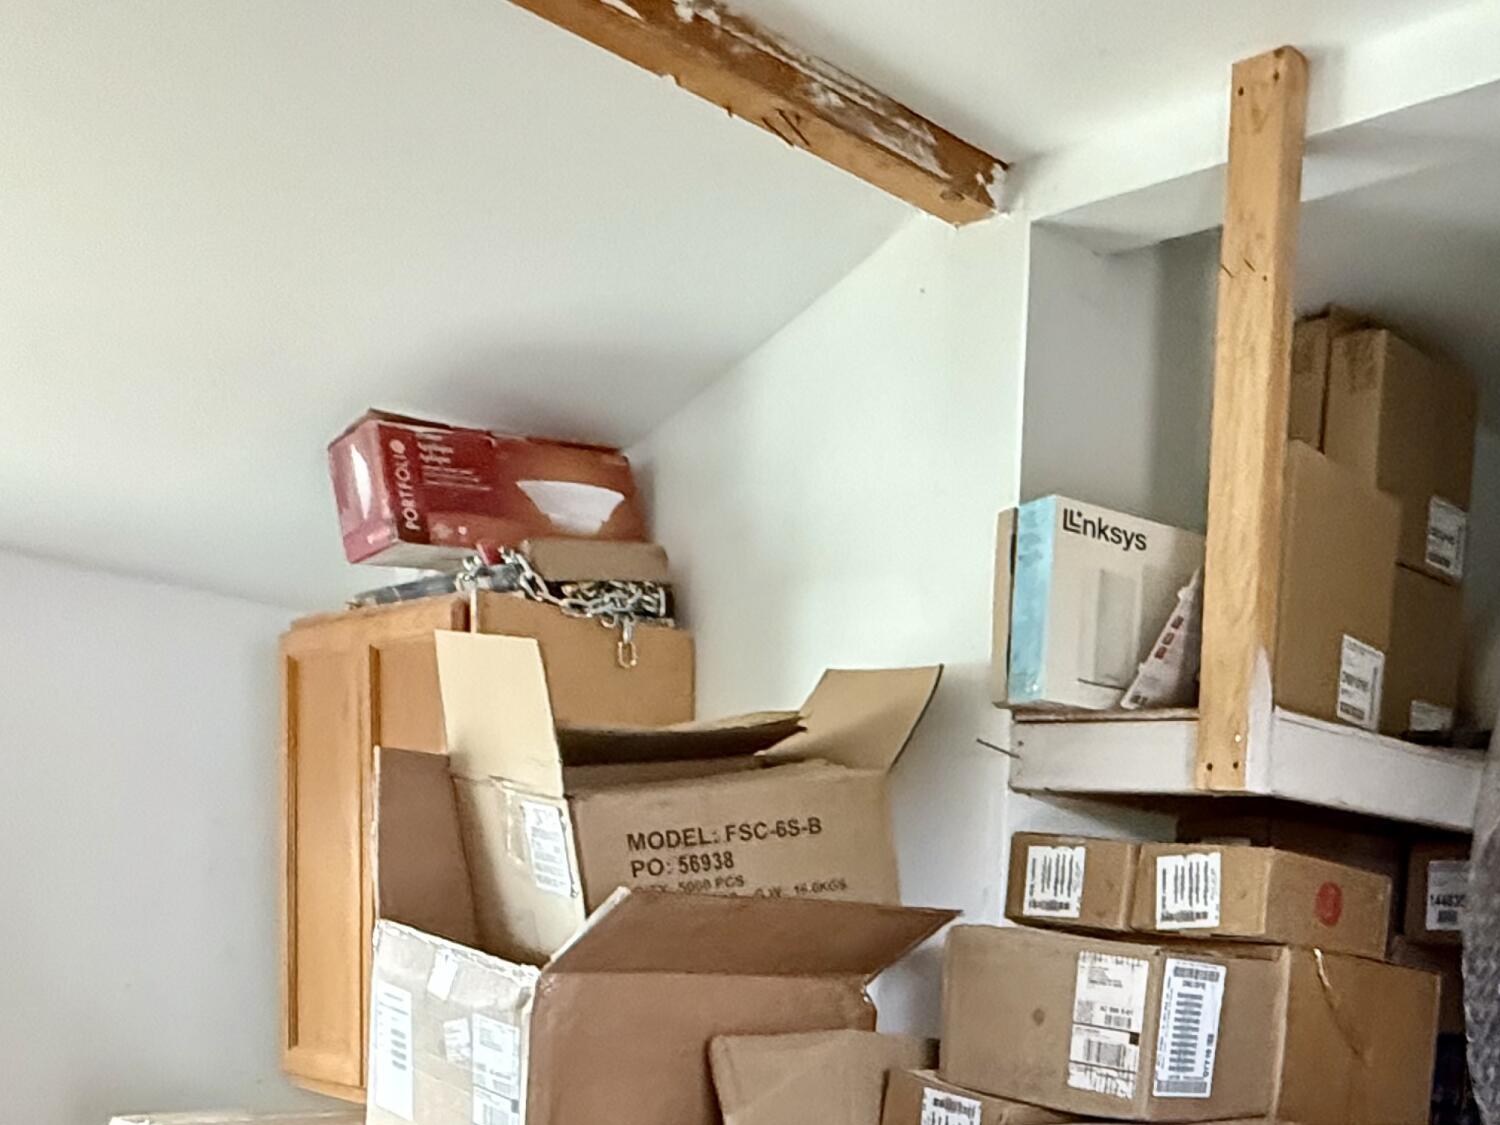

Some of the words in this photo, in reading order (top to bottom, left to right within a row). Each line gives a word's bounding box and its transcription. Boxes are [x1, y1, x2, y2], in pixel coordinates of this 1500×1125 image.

[389, 439, 421, 531] PORTFOLIO
[1063, 508, 1147, 552] Linksys
[626, 828, 720, 852] MODEL:
[725, 817, 822, 842] FSC-6S-B
[630, 858, 671, 878] PO:
[678, 851, 734, 875] 56938
